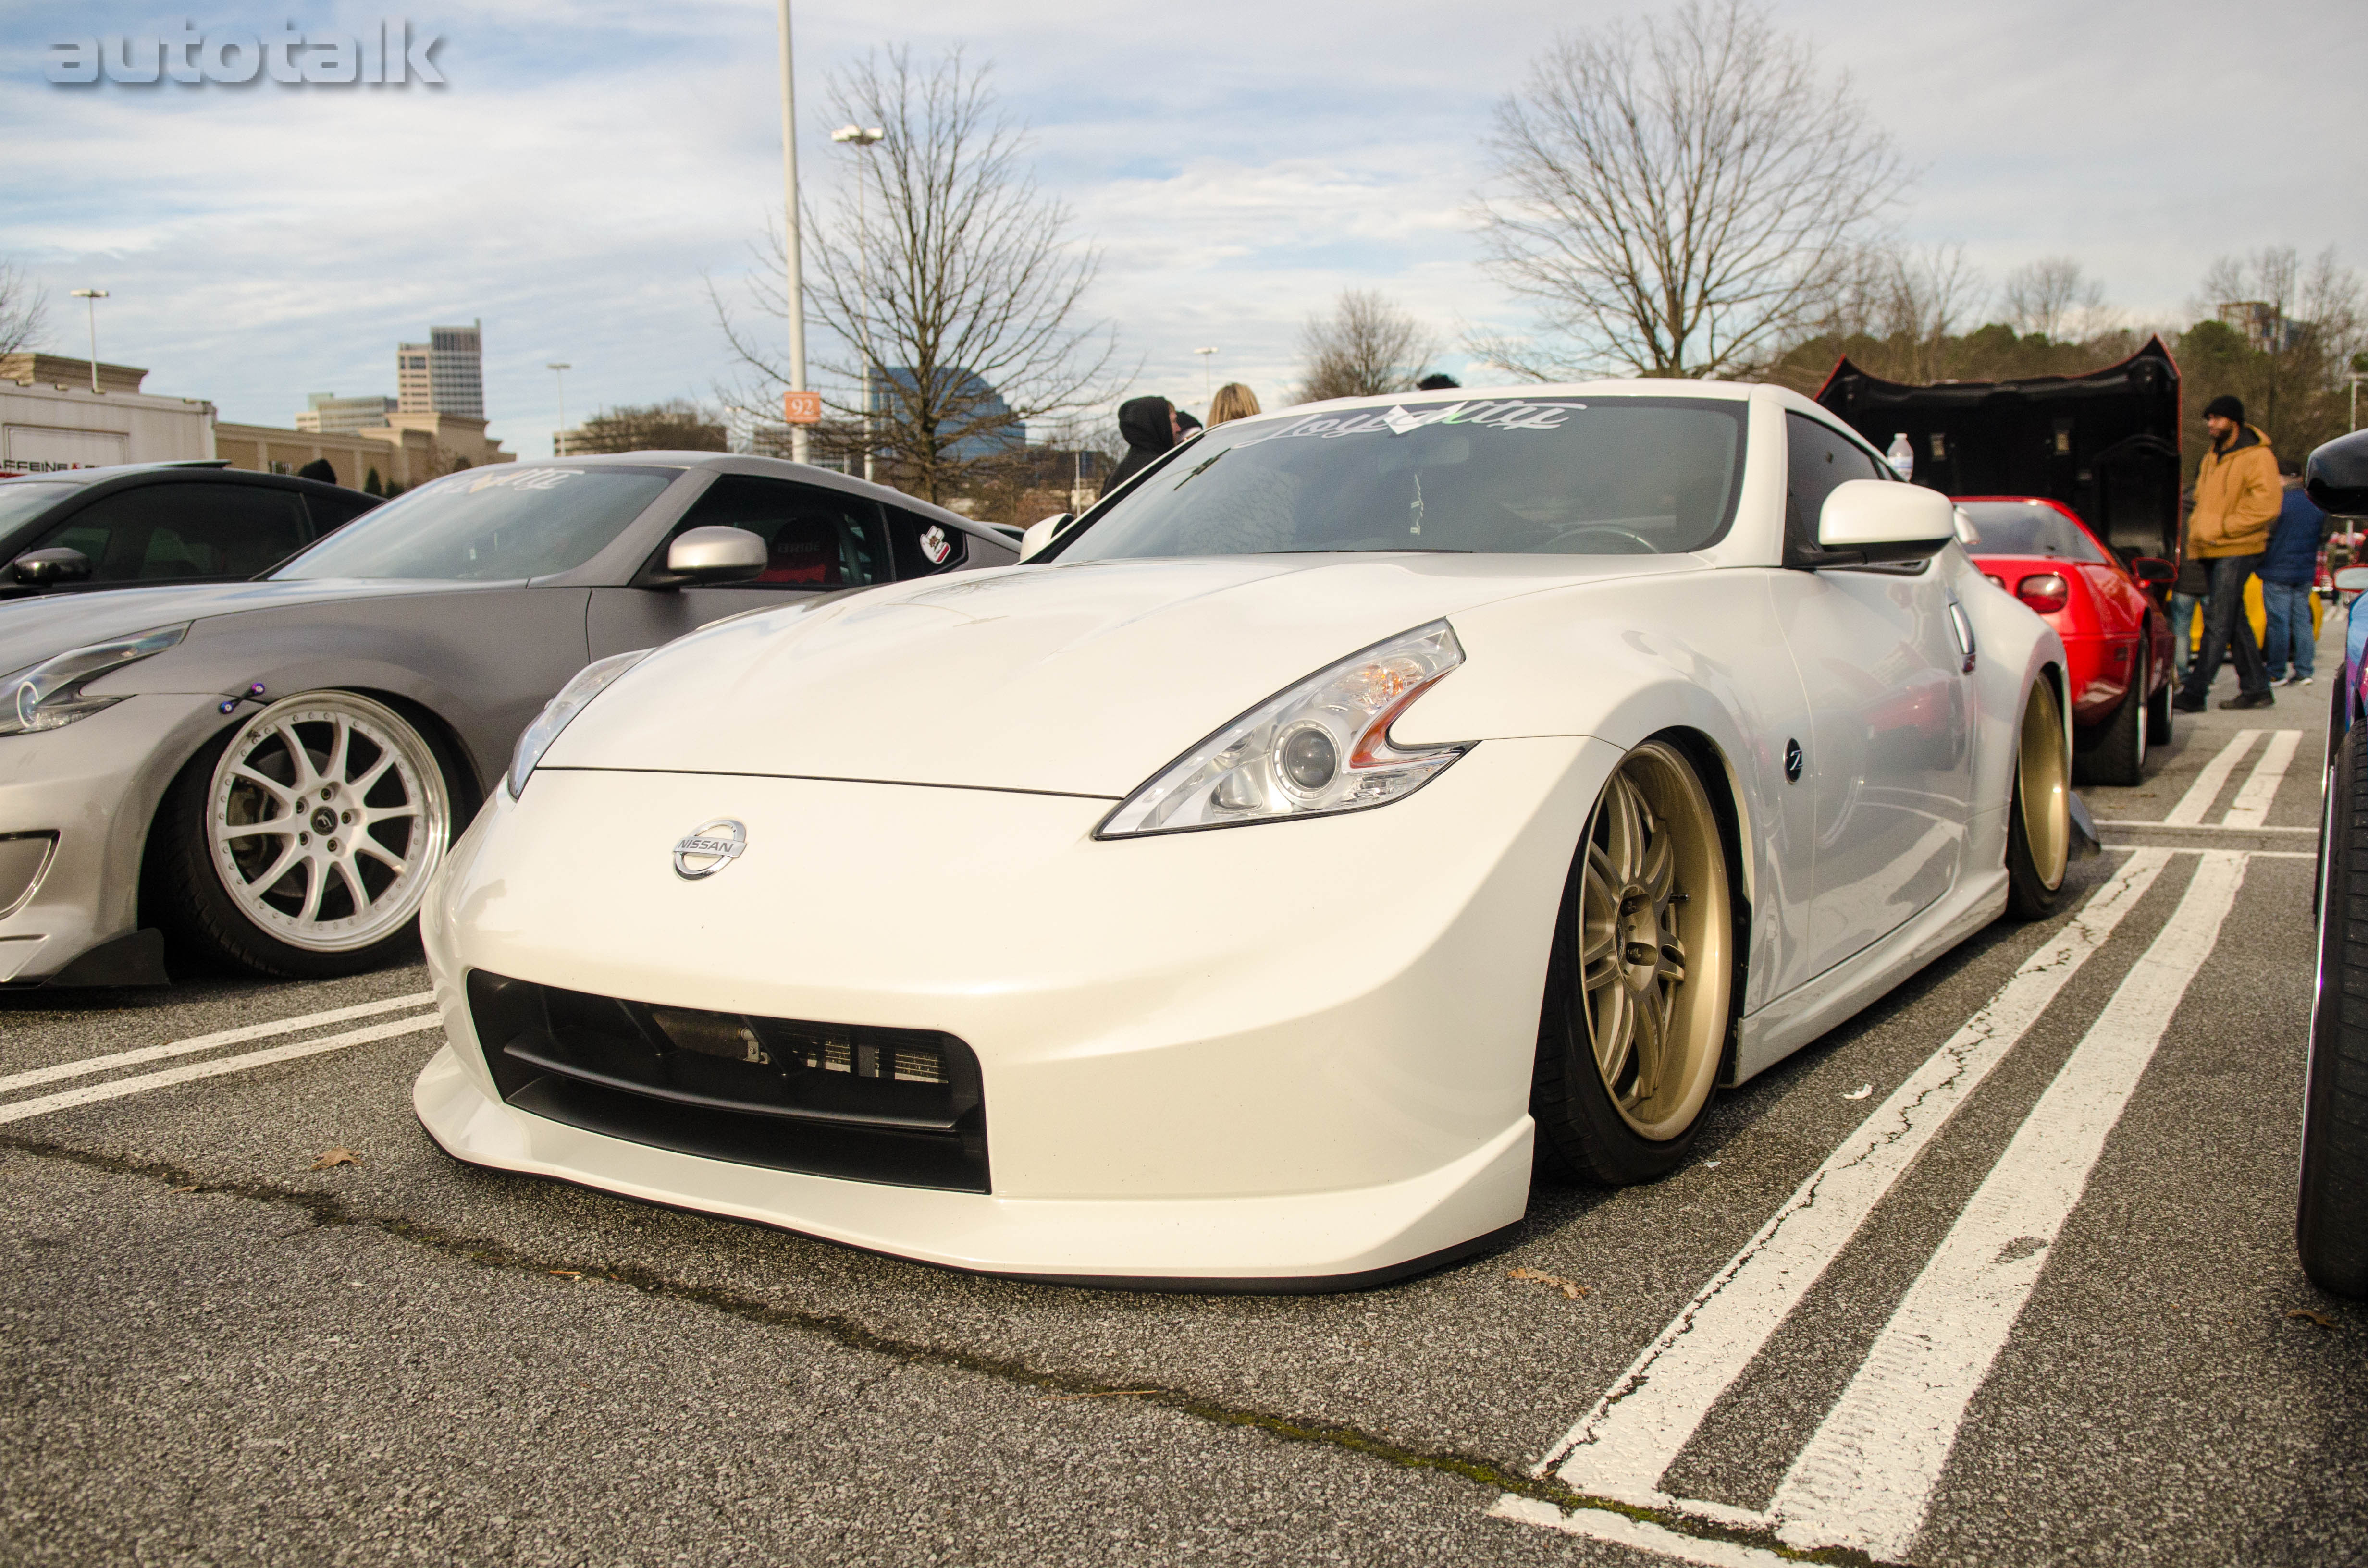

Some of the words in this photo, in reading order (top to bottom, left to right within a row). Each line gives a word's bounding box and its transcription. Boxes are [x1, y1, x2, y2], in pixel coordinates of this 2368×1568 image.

[791, 398, 814, 416] 92
[1231, 400, 1587, 449] Loyalty
[0, 460, 68, 472] FFEINE
[678, 839, 734, 852] NISSAN
